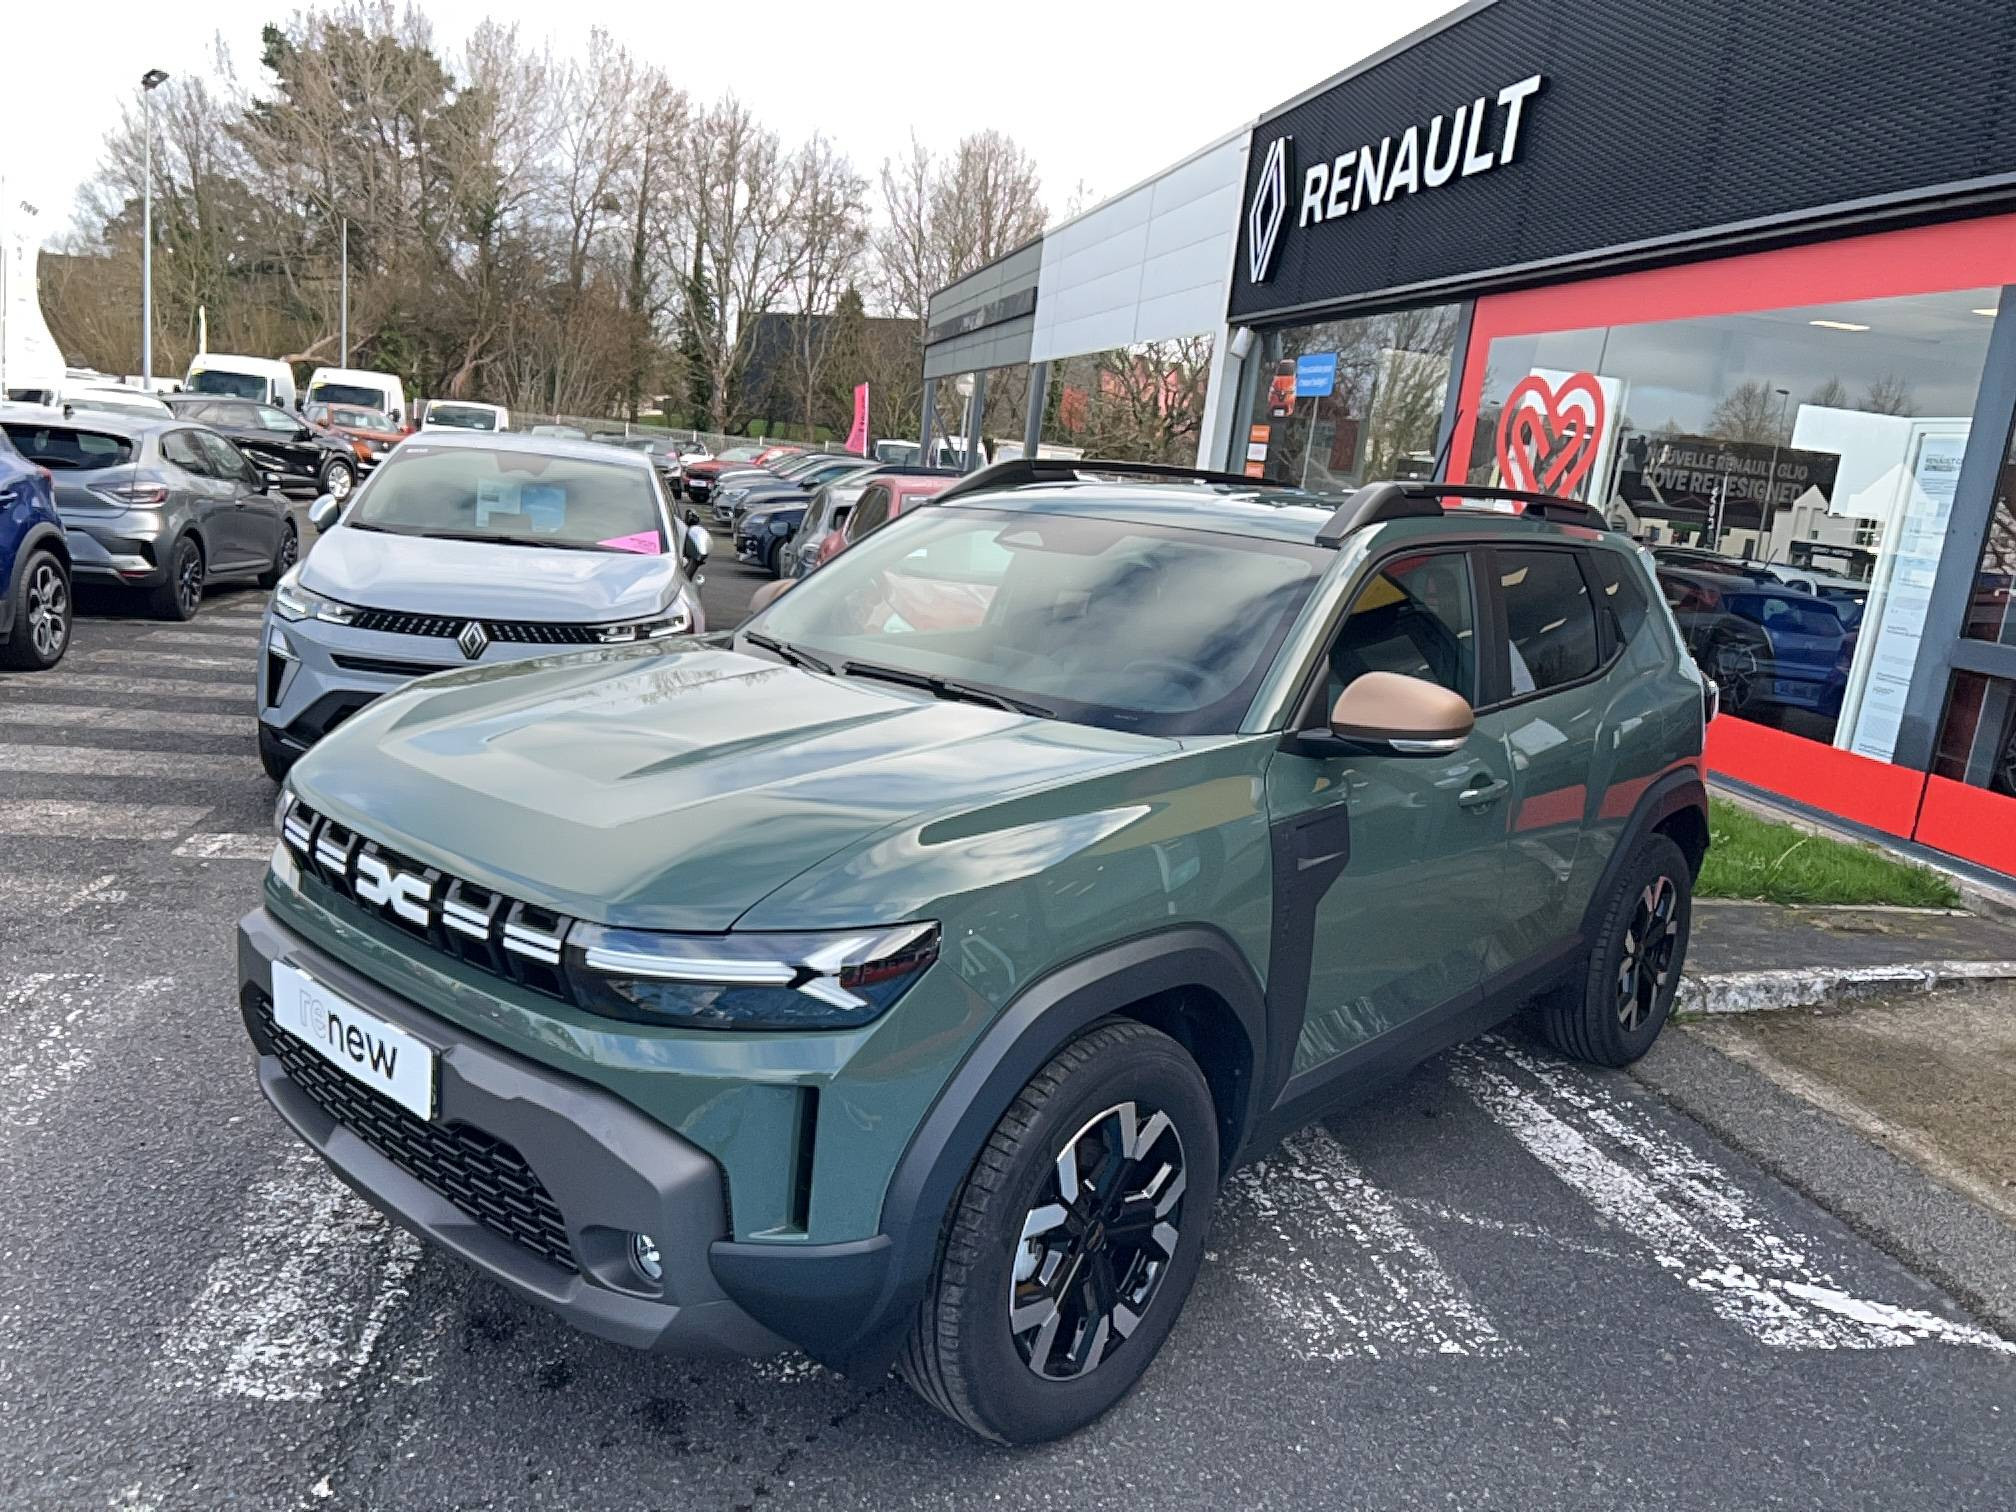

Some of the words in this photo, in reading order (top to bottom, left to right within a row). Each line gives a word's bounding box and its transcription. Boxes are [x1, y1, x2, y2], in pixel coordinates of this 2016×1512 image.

[1299, 74, 1541, 228] RENAULT
[1777, 463, 1809, 481] CLIO
[299, 987, 398, 1081] renew
